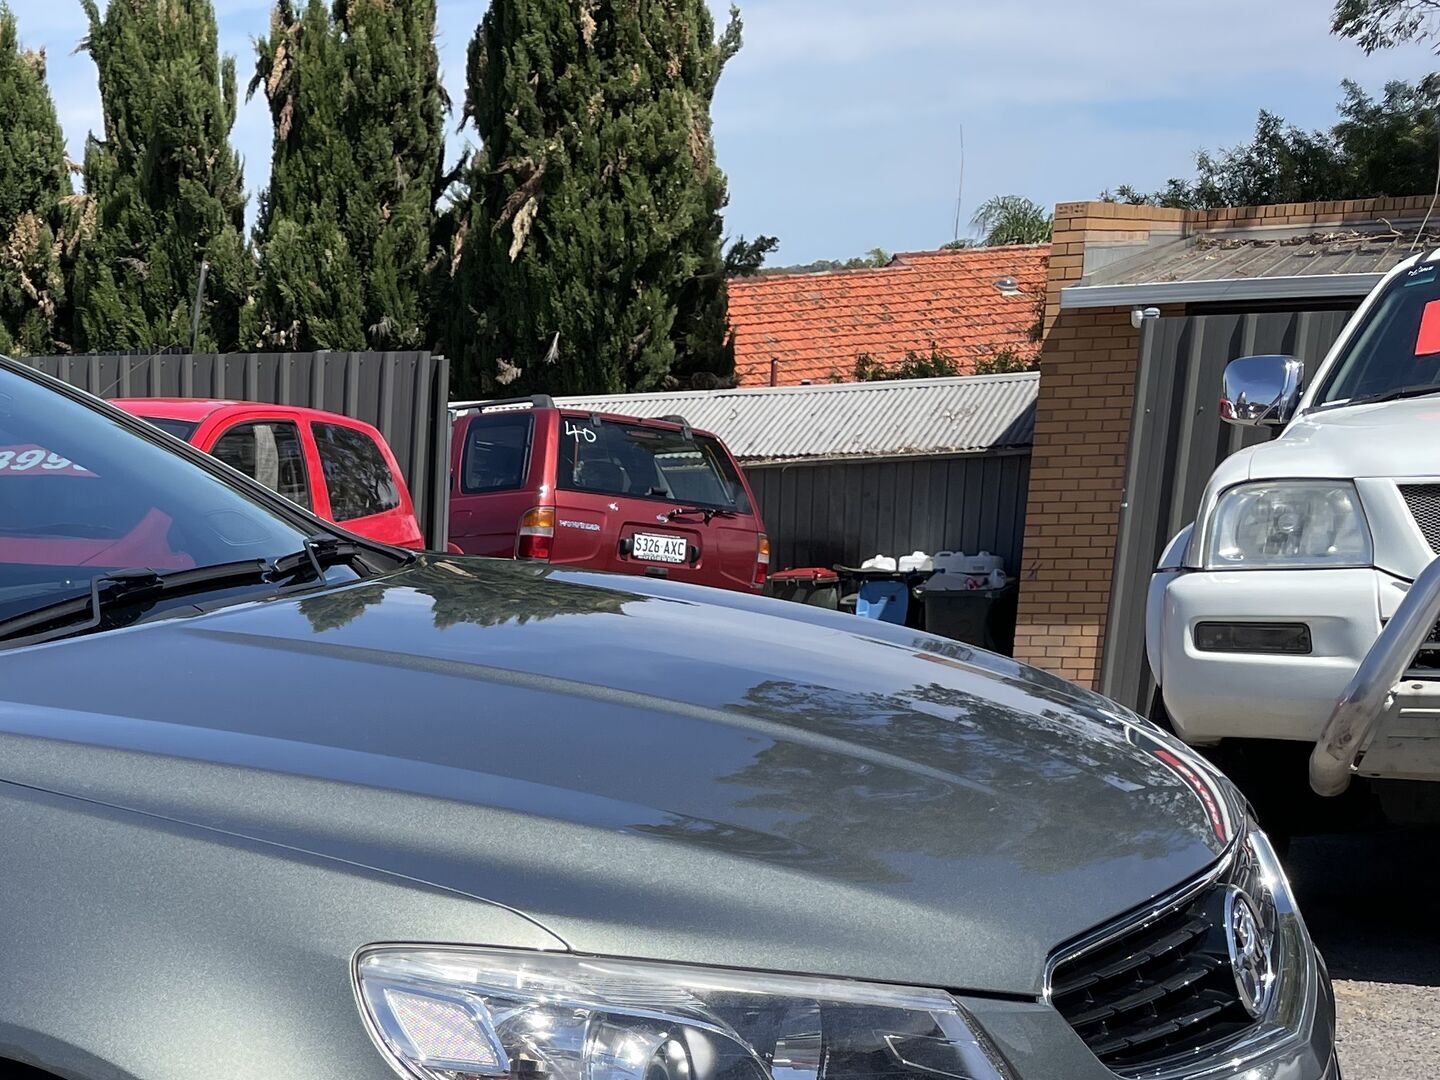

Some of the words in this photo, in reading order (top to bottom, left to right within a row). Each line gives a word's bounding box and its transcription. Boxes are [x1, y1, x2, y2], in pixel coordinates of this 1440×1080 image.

[564, 420, 597, 443] 40
[635, 537, 660, 553] S326
[663, 540, 684, 556] AXC
